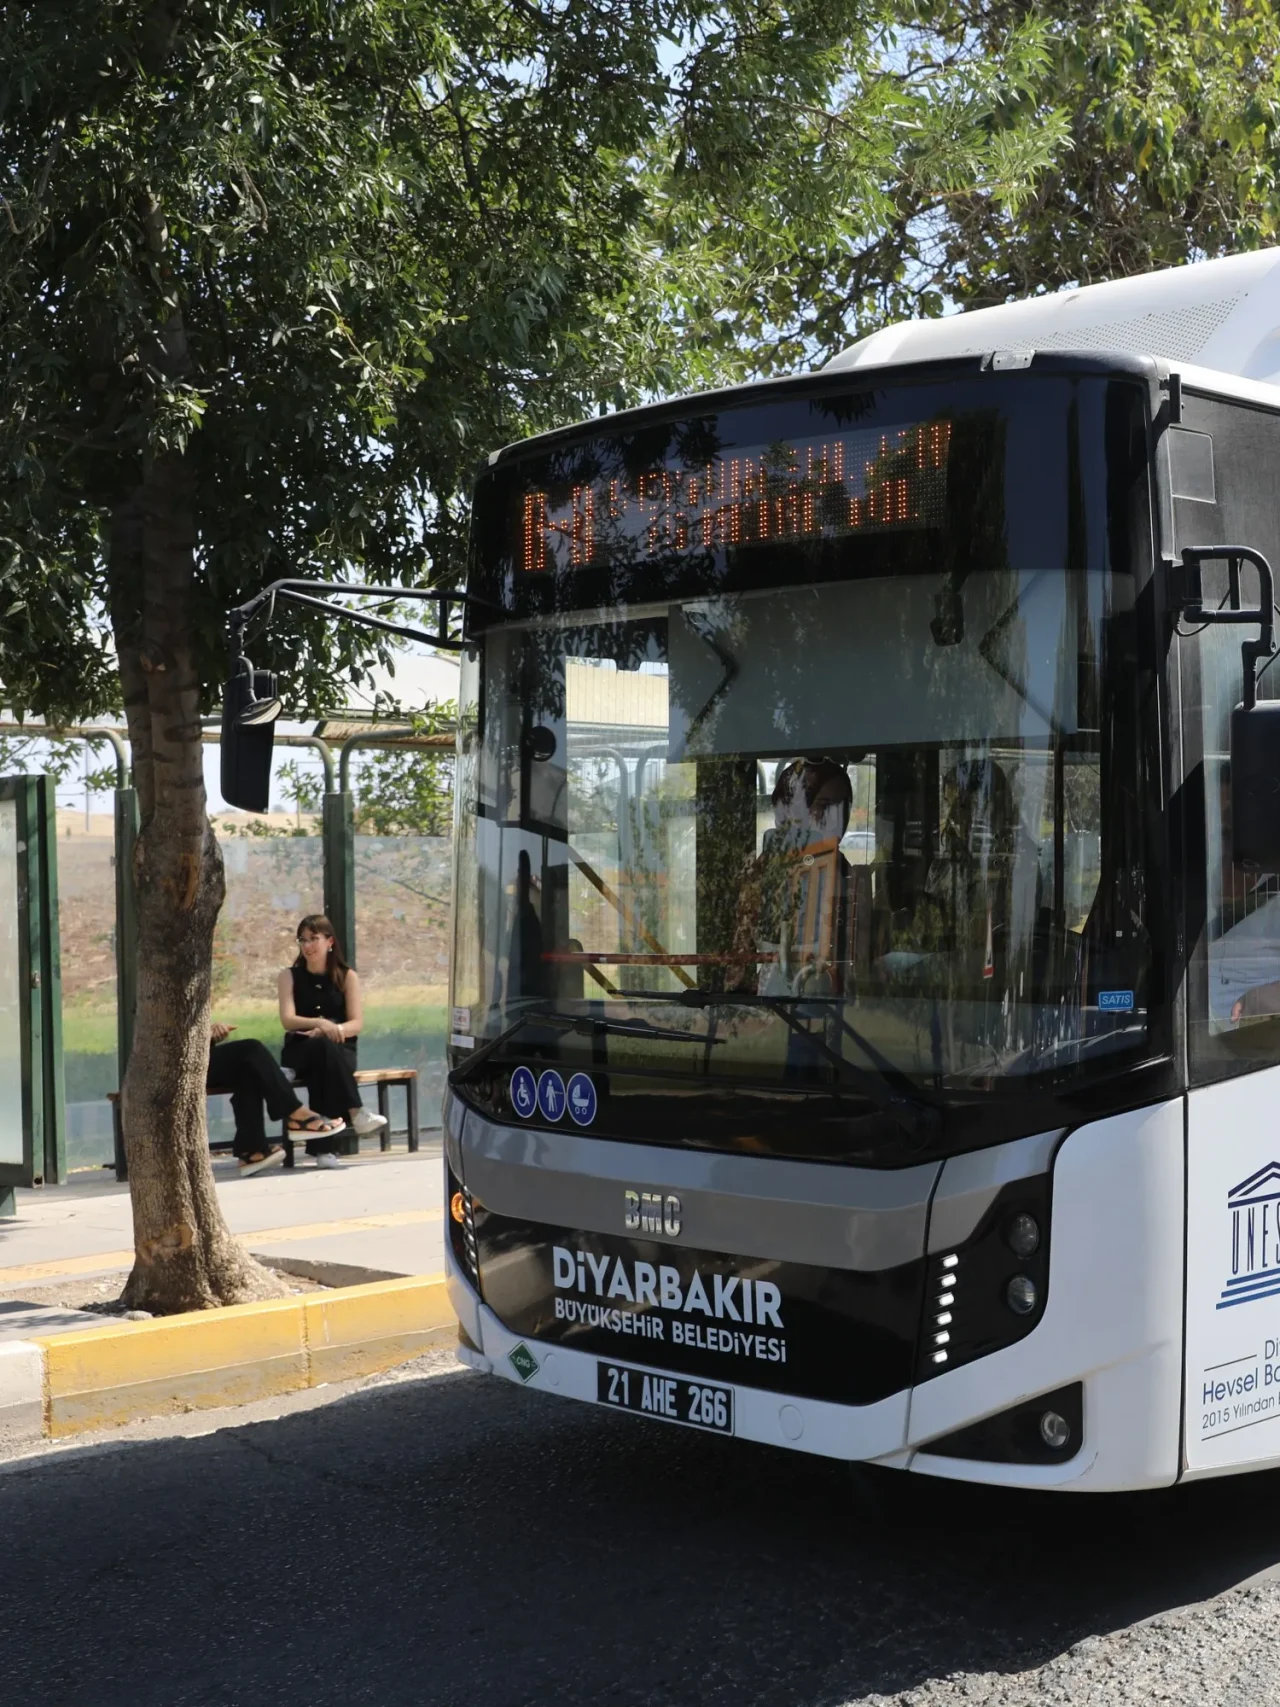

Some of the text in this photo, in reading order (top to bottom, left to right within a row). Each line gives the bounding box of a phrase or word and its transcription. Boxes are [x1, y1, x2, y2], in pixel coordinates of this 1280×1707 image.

[624, 1189, 681, 1237] BMC
[607, 1367, 728, 1428] 21 AHE 266
[1202, 1366, 1259, 1406] Hevsel
[1201, 1407, 1231, 1430] 2015
[1232, 1396, 1275, 1419] Yılından
